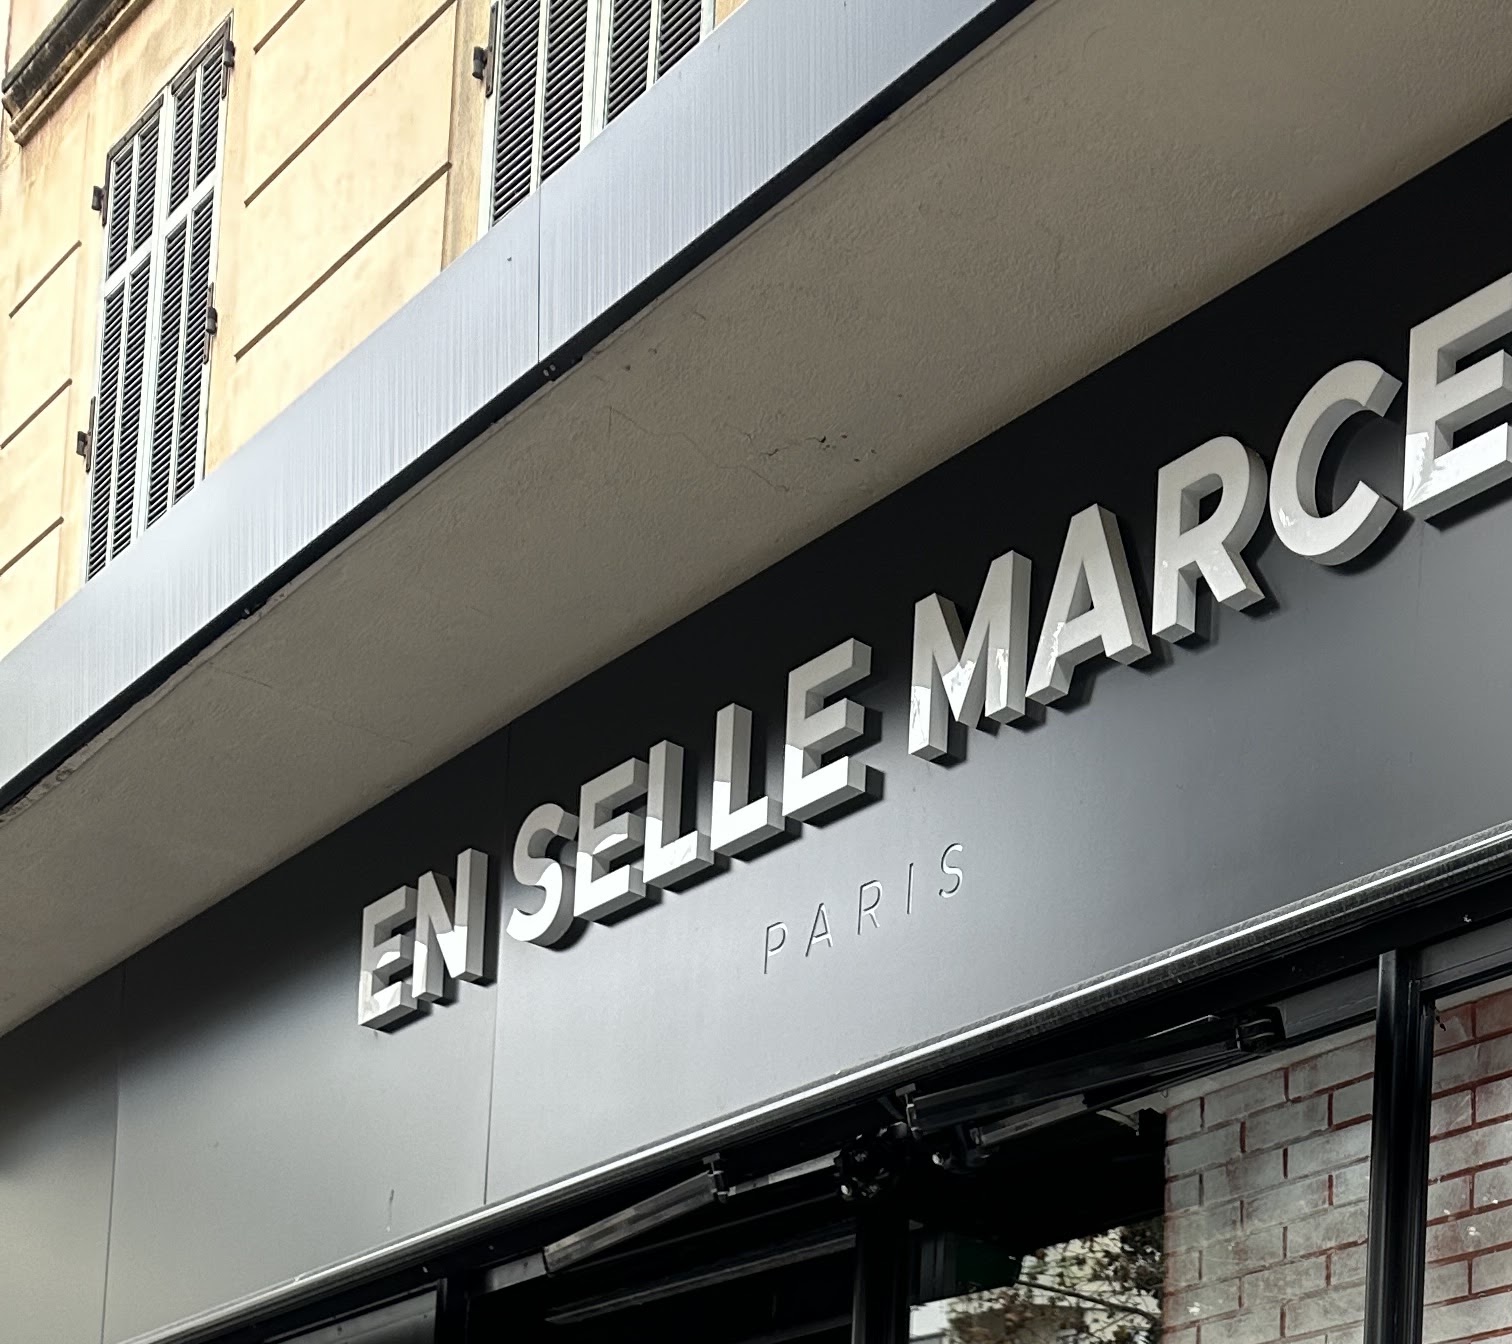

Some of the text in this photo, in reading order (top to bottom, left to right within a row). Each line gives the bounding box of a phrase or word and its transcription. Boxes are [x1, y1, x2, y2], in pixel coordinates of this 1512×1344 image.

[357, 847, 489, 1029] EN
[505, 637, 872, 946] SELLE
[763, 841, 968, 976] PARIS
